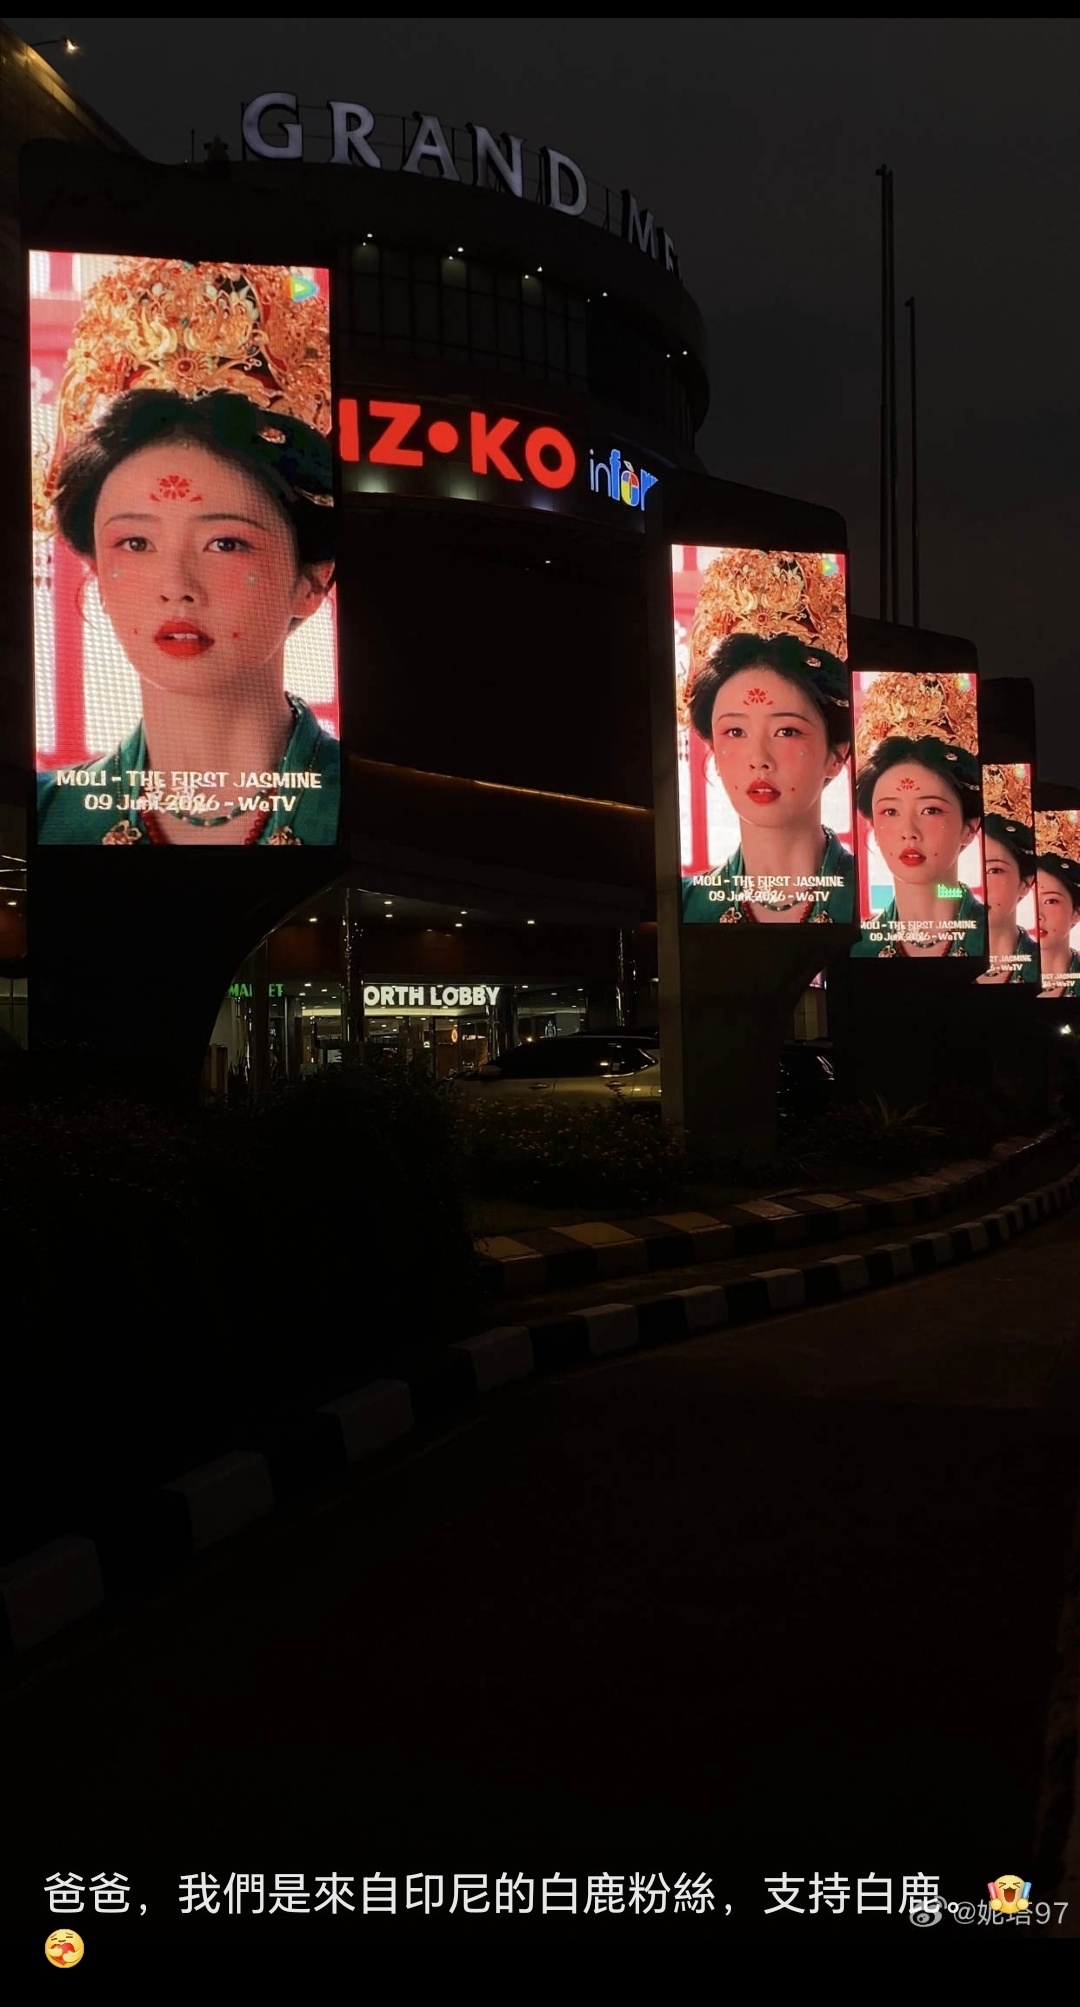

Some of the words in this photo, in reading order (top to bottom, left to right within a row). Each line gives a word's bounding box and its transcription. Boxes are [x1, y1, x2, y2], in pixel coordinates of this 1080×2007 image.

[242, 91, 588, 217] GRAND
[56, 770, 106, 787] MOLI
[126, 770, 166, 788] THE
[171, 771, 229, 788] FIRST
[233, 771, 322, 788] JASMINE
[84, 794, 113, 811] 09
[238, 796, 296, 812] WeTV
[693, 876, 722, 887] MOLI
[732, 875, 755, 888] THE
[757, 876, 791, 888] FIRST
[793, 876, 844, 887] JASMINE
[709, 891, 725, 901] 09
[795, 890, 830, 902] WeTV
[888, 920, 906, 931] THE
[908, 920, 934, 930] FIRST
[935, 920, 977, 929] JASMINE
[870, 932, 883, 941] 09
[938, 931, 966, 941] WeTV
[363, 985, 425, 1006] ORTH
[430, 986, 500, 1006] LOBBY
